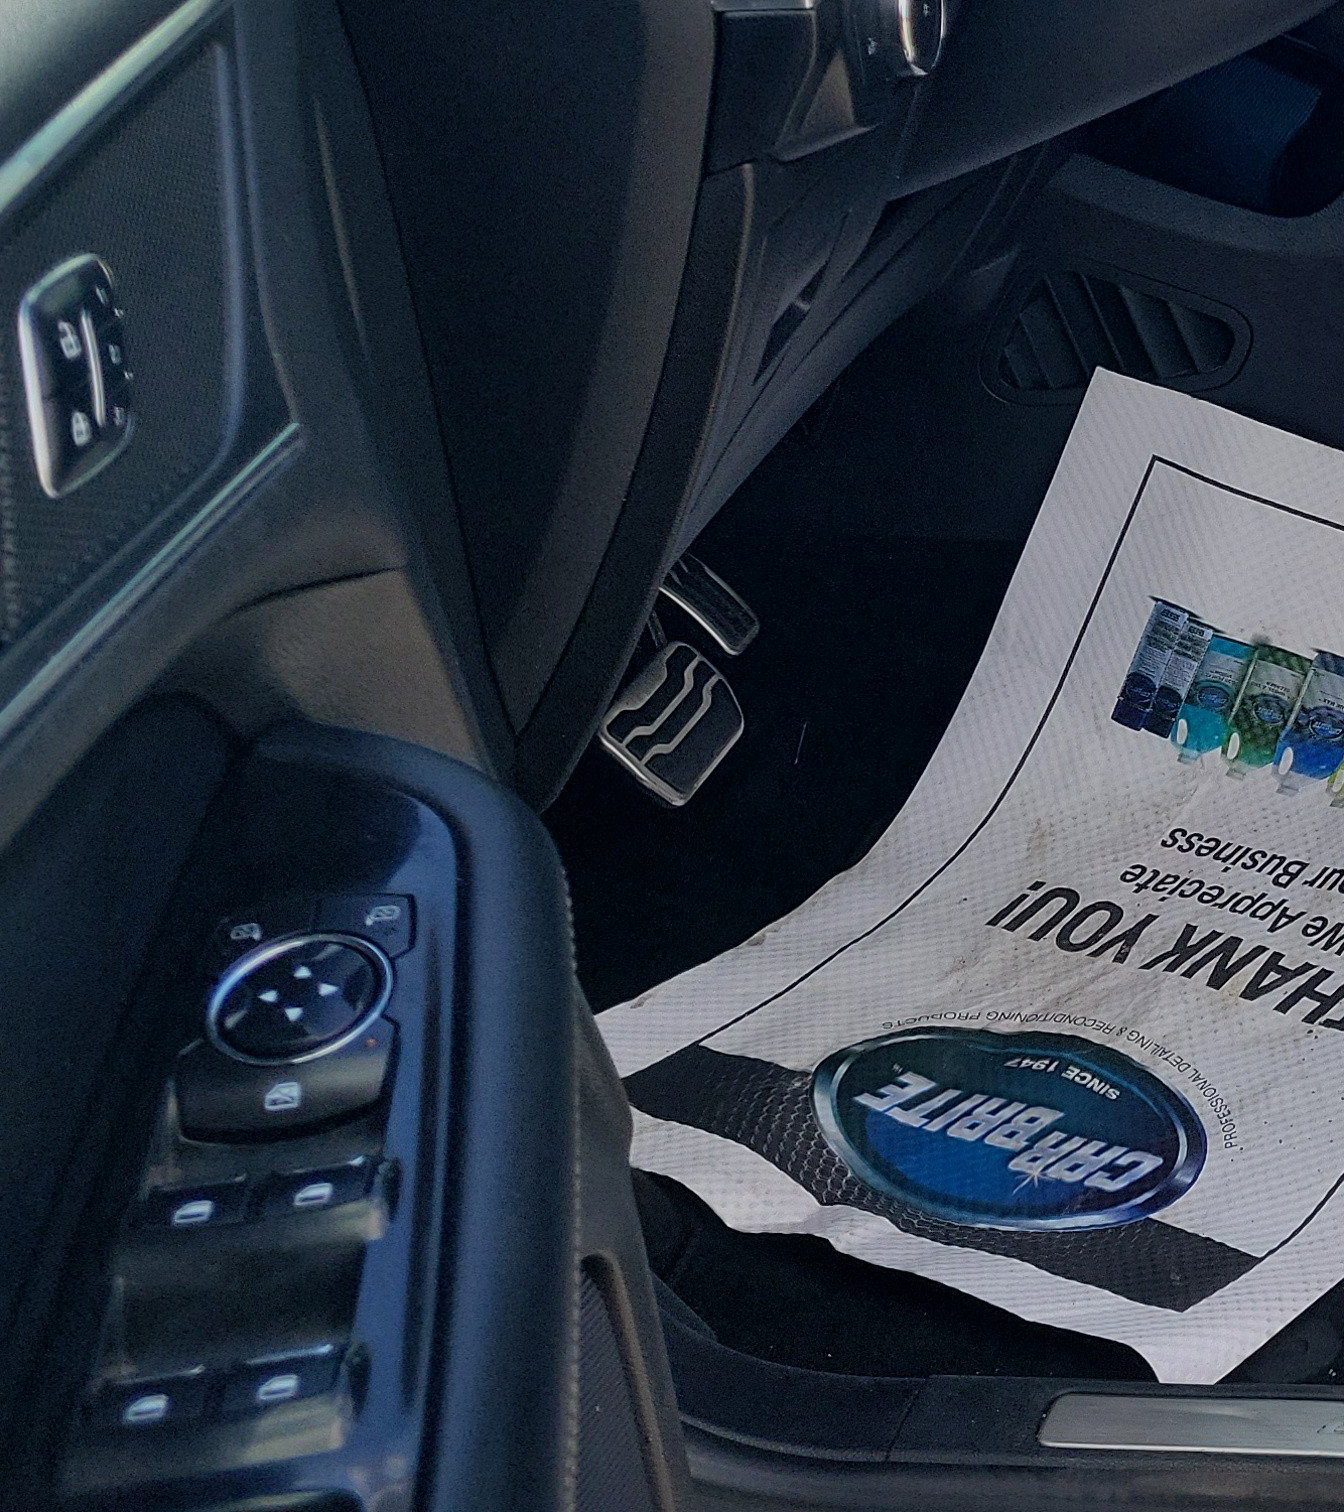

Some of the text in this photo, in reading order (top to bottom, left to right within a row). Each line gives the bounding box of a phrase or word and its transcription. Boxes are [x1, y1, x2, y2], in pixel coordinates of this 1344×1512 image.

[1161, 827, 1309, 889] Business
[985, 880, 1159, 963] YOU!
[1120, 863, 1301, 934] Appreciate
[882, 1010, 1238, 1148] PROFESSIONAL DETAILING & RECONDITIONING PRODUCTS
[1004, 1056, 1120, 1100] SINCE 1947
[855, 1071, 1163, 1192] CAR BRITE
